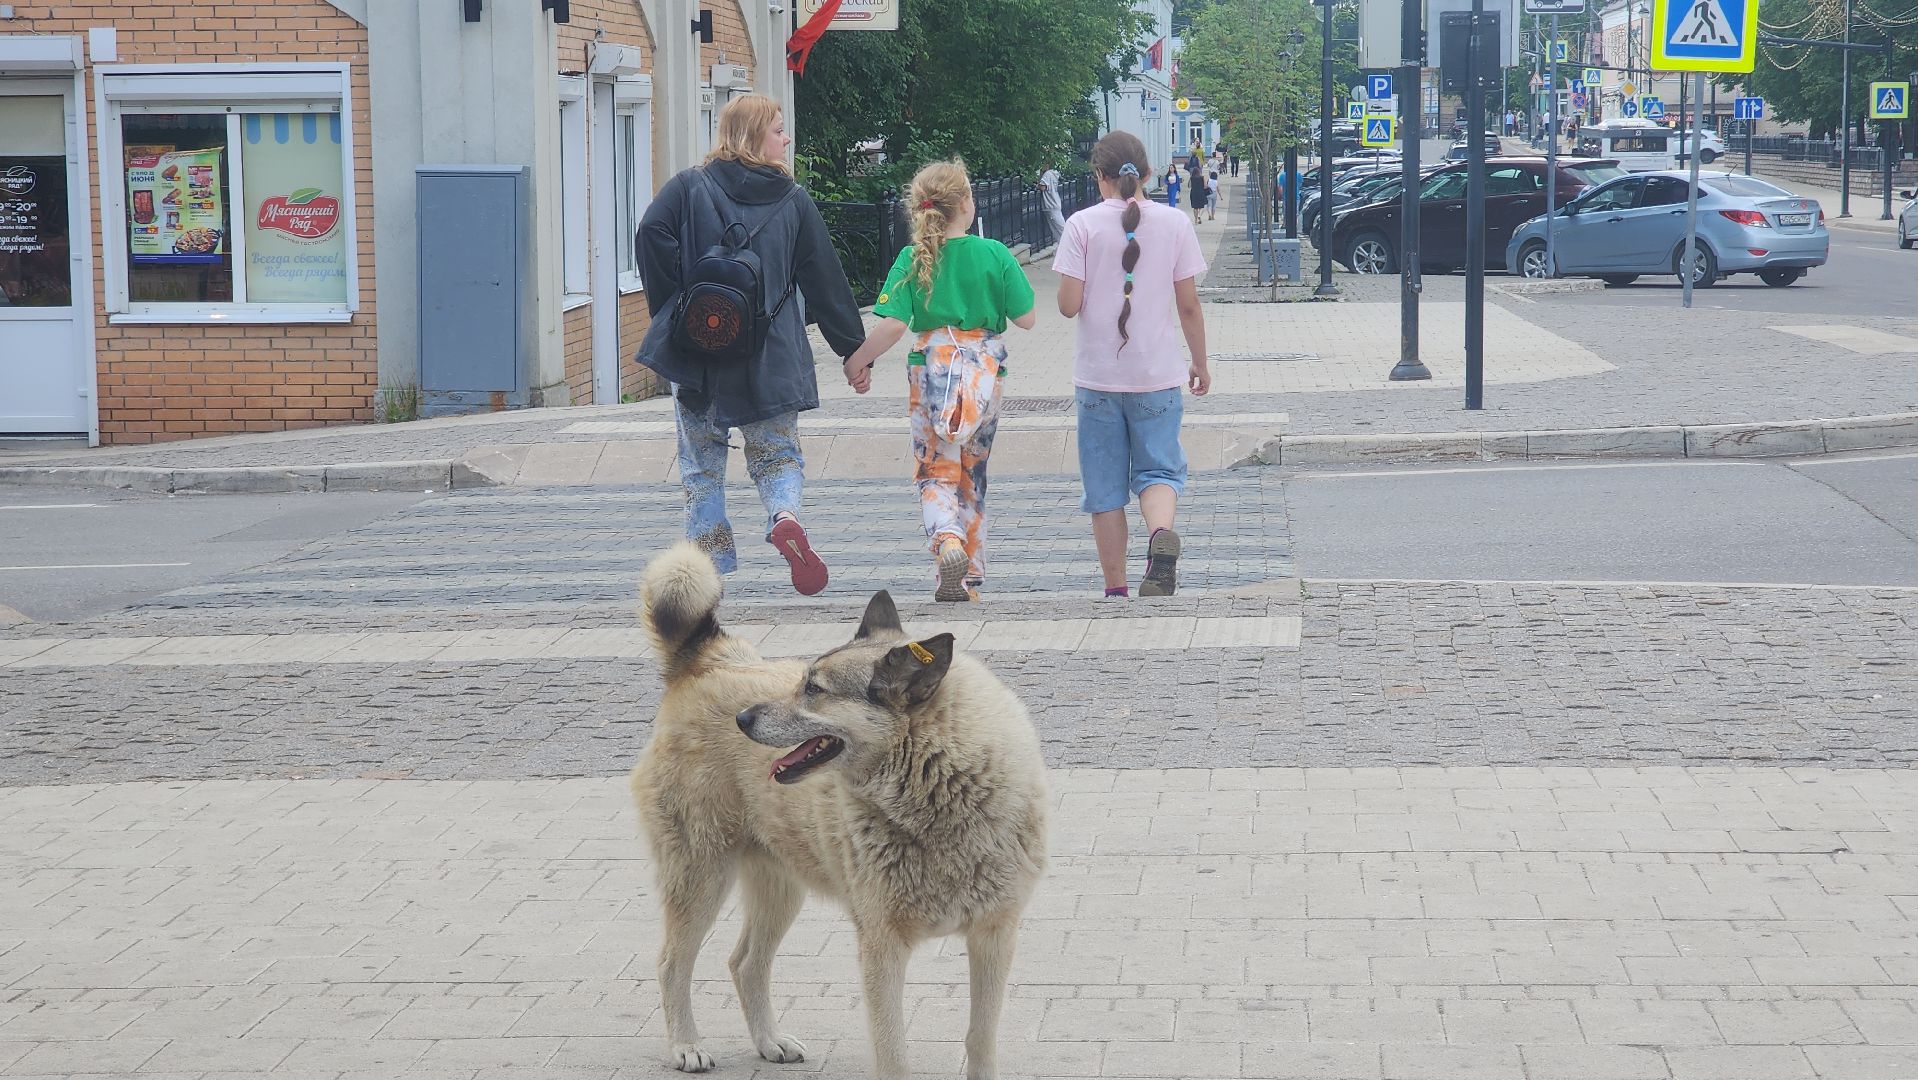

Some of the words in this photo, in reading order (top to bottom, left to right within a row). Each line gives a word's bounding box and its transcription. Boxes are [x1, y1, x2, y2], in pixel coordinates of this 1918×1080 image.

[1374, 78, 1388, 97] P
[260, 204, 335, 223] Мясницкий
[289, 216, 312, 232] Ряд
[252, 251, 290, 266] Всегда
[264, 267, 303, 281] Всегда
